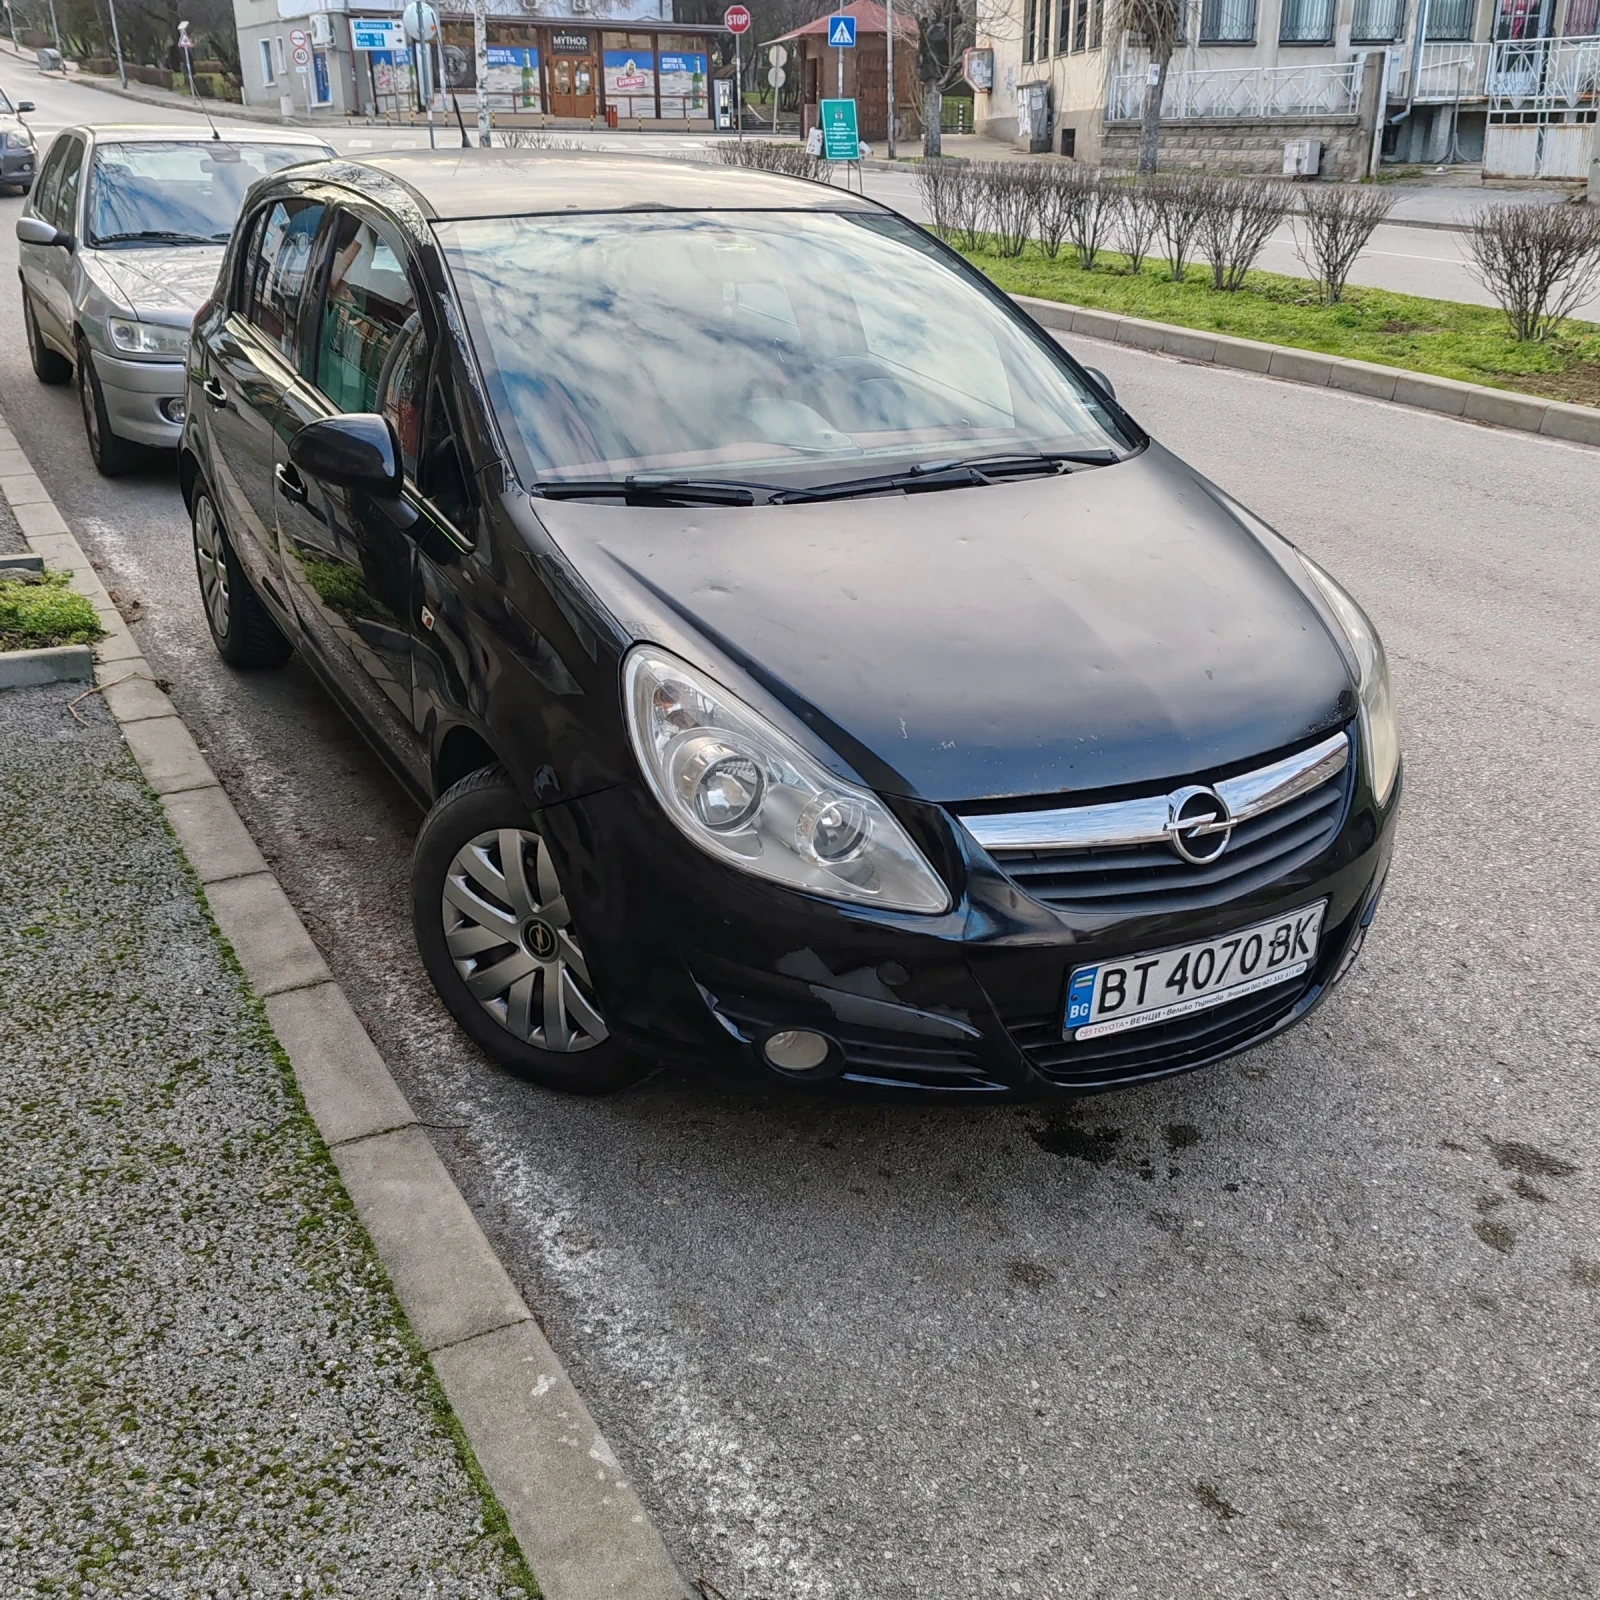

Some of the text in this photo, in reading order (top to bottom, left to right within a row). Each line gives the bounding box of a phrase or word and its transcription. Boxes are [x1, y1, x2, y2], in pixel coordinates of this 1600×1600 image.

[727, 14, 748, 25] STOP
[553, 35, 587, 46] MYTHOS
[296, 51, 305, 60] 40
[1098, 912, 1316, 1014] BT 4070 BK
[1070, 1003, 1089, 1018] BG
[1094, 1021, 1125, 1034] TOYOTA
[1129, 1011, 1161, 1025] ВЕНЦИ
[1166, 1004, 1193, 1016] Велико
[1194, 995, 1224, 1008] Търново
